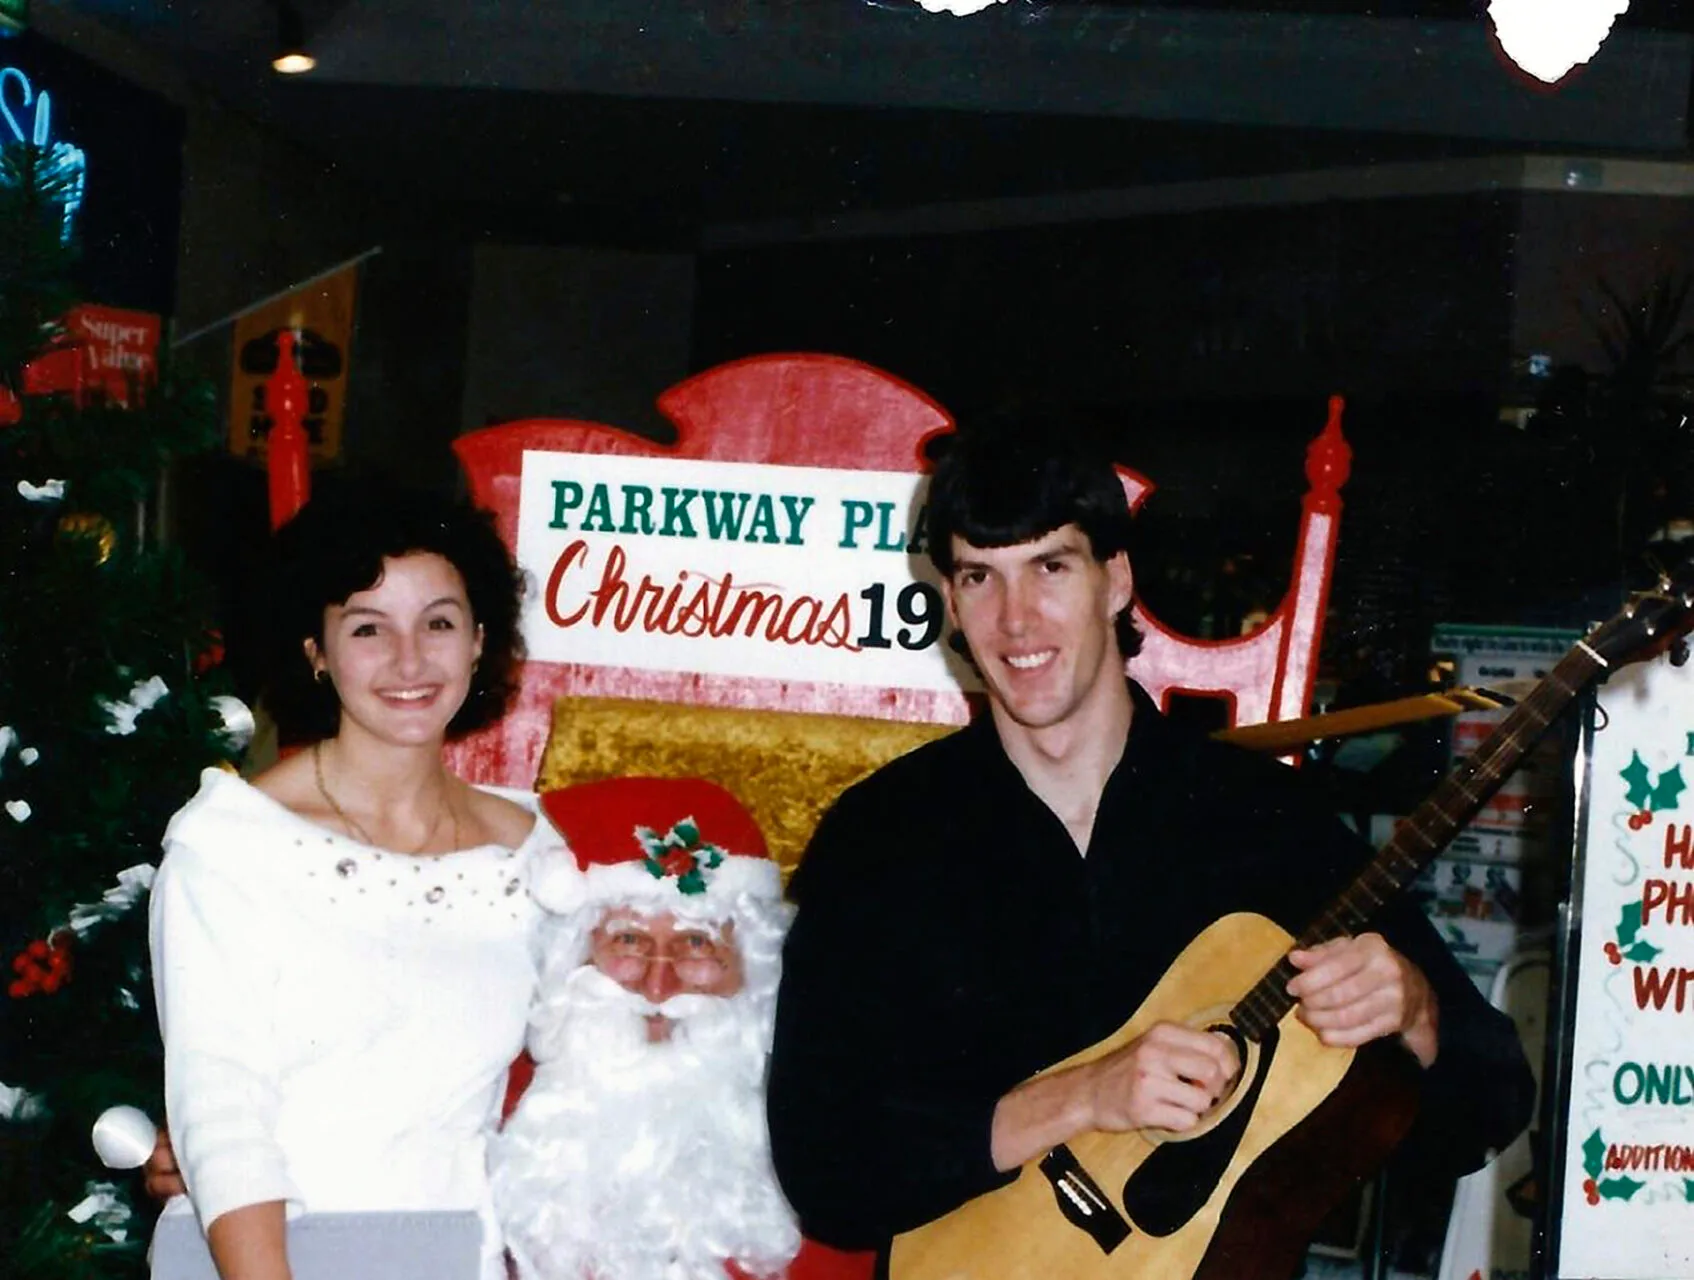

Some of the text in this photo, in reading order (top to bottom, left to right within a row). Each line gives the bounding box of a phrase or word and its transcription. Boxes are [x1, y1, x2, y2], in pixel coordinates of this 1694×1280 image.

[81, 313, 149, 346] Super
[548, 480, 815, 545] PARKWAY
[545, 539, 943, 653] Christmas 19
[1641, 879, 1694, 926] PH
